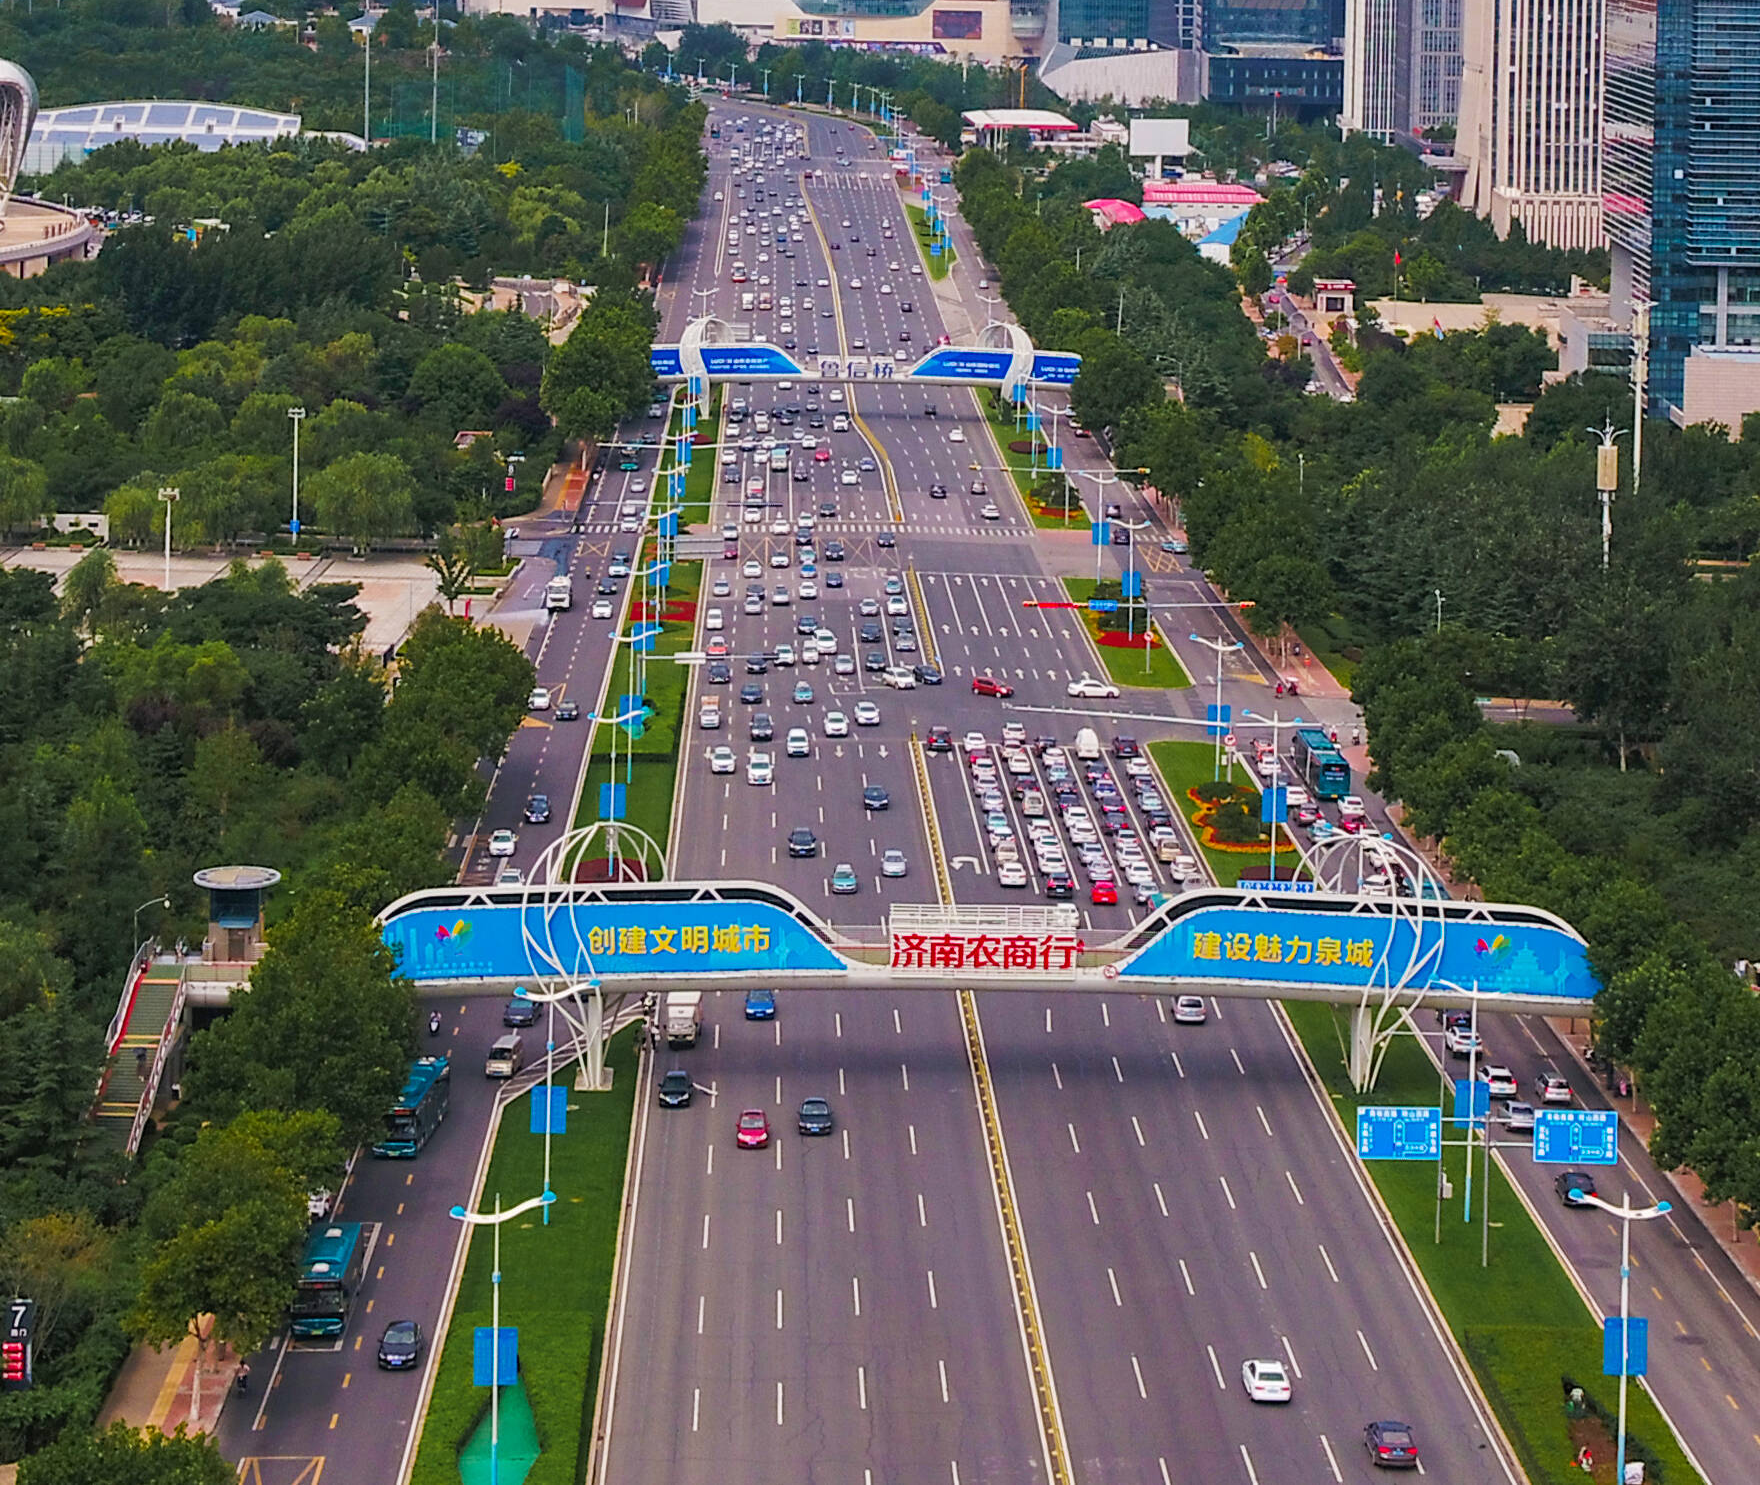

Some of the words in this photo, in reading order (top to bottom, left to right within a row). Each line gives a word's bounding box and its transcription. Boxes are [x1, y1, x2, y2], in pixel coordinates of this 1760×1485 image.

[588, 924, 771, 956] 创建文明城市
[891, 933, 1076, 970] 济南农商行
[1193, 930, 1375, 968] 建设魅力泉城
[11, 1305, 27, 1328] 7
